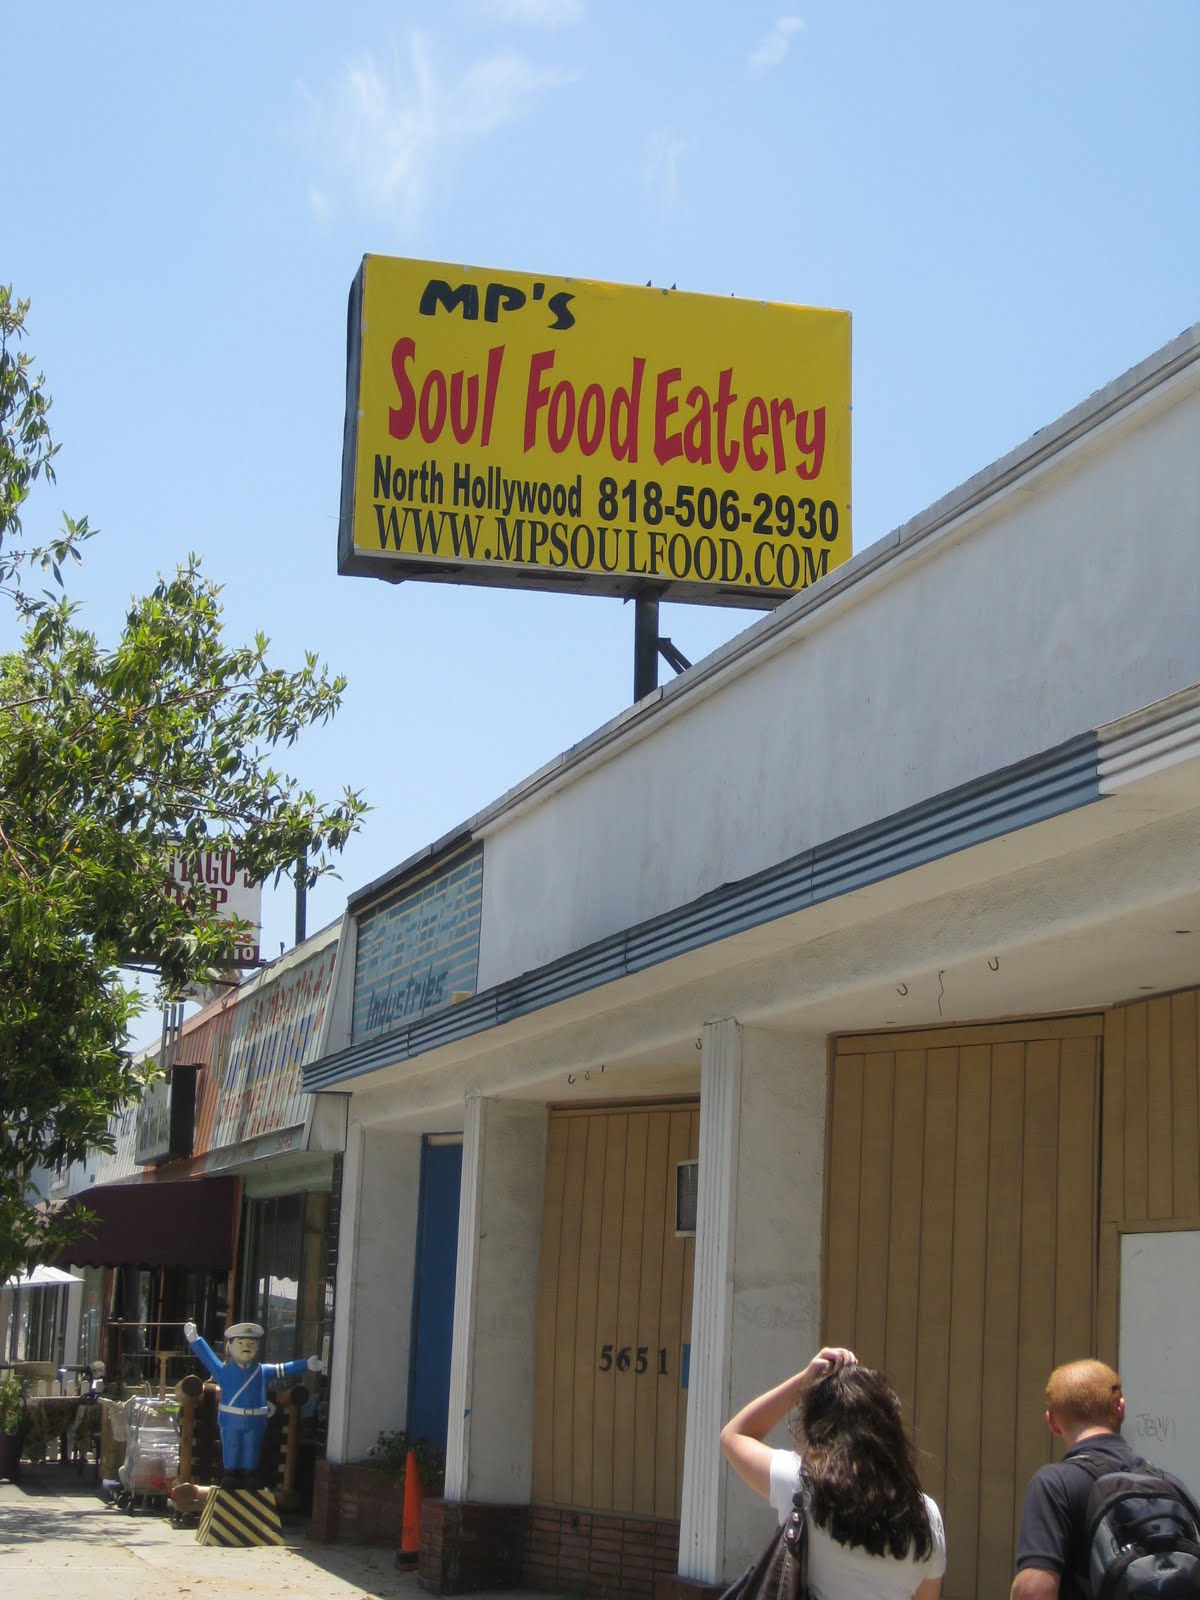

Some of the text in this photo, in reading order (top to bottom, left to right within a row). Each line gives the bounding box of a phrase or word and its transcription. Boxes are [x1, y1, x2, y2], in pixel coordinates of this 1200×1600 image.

[418, 280, 576, 330] MP'S
[389, 337, 826, 481] Soul Food Eatery
[374, 454, 839, 542] North Hollywood 818-506-2930
[373, 503, 831, 588] WWW.MPSOULFOOD.COM
[599, 1344, 668, 1375] 5651
